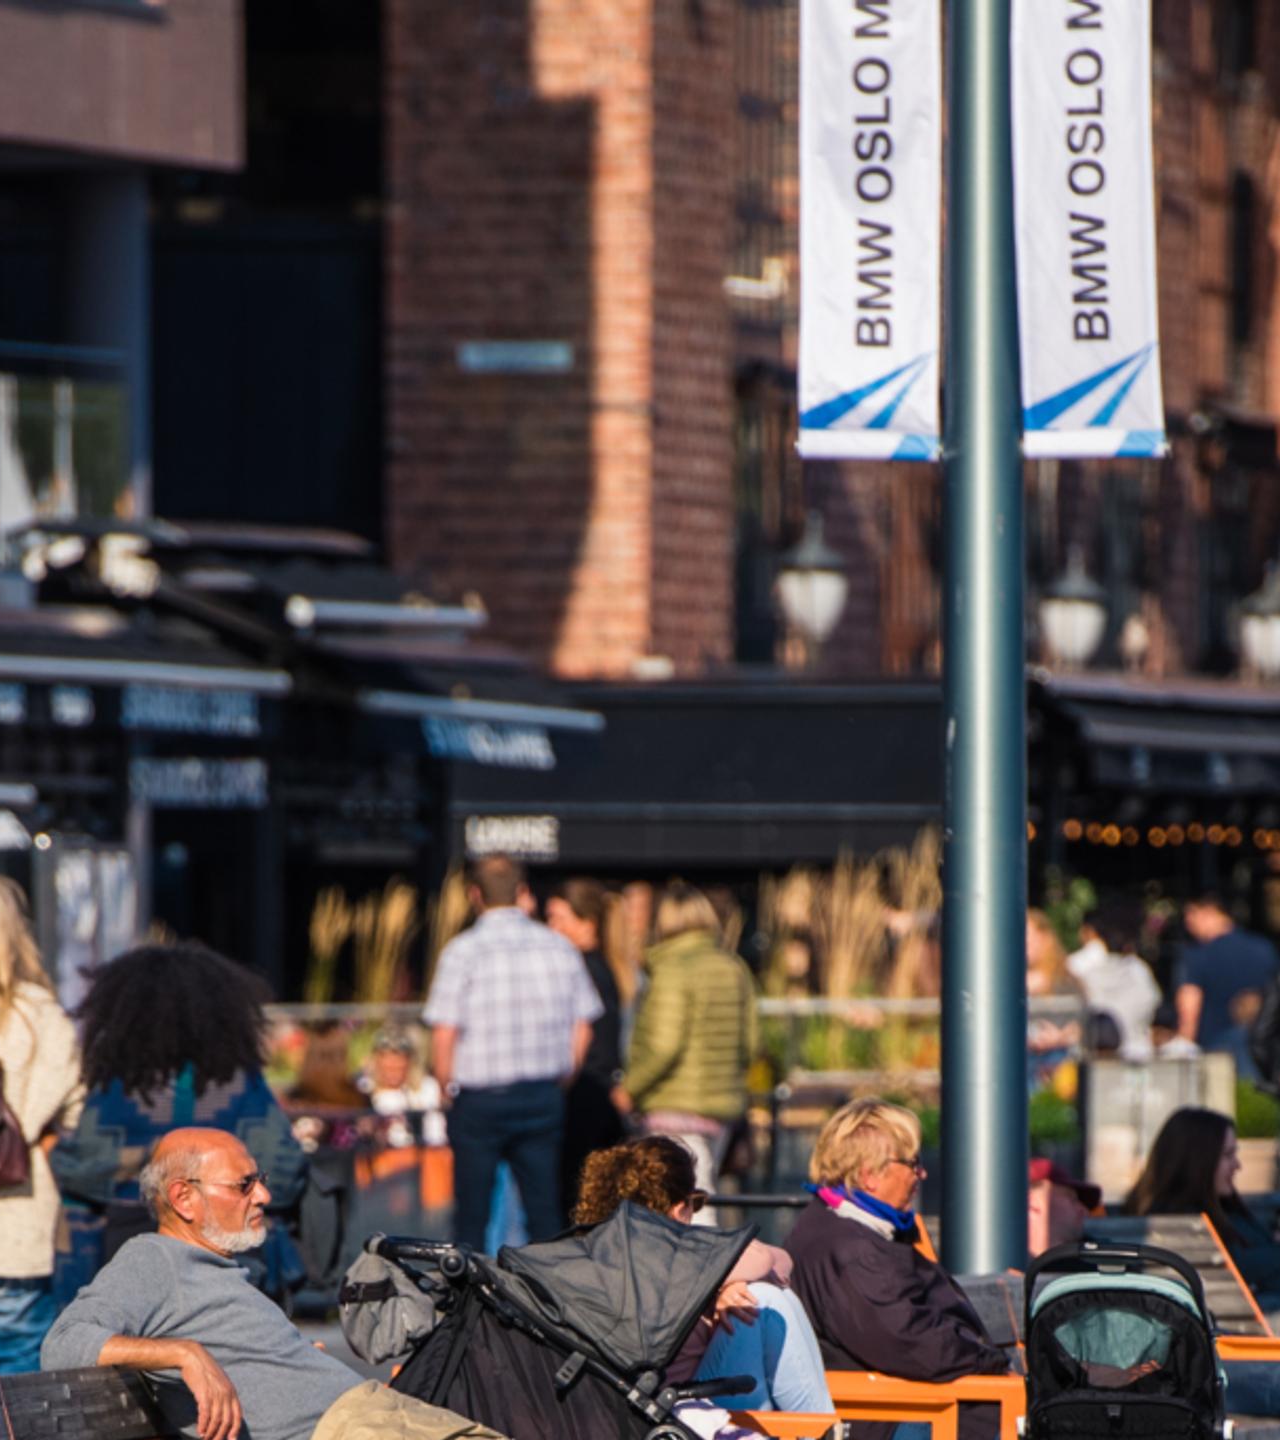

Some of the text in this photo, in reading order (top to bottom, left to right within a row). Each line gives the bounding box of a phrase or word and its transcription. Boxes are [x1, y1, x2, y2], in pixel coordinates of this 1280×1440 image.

[851, 56, 895, 204] OSLO
[1064, 47, 1107, 198] OSLO
[854, 217, 894, 349] BMW
[1067, 211, 1112, 343] BMW
